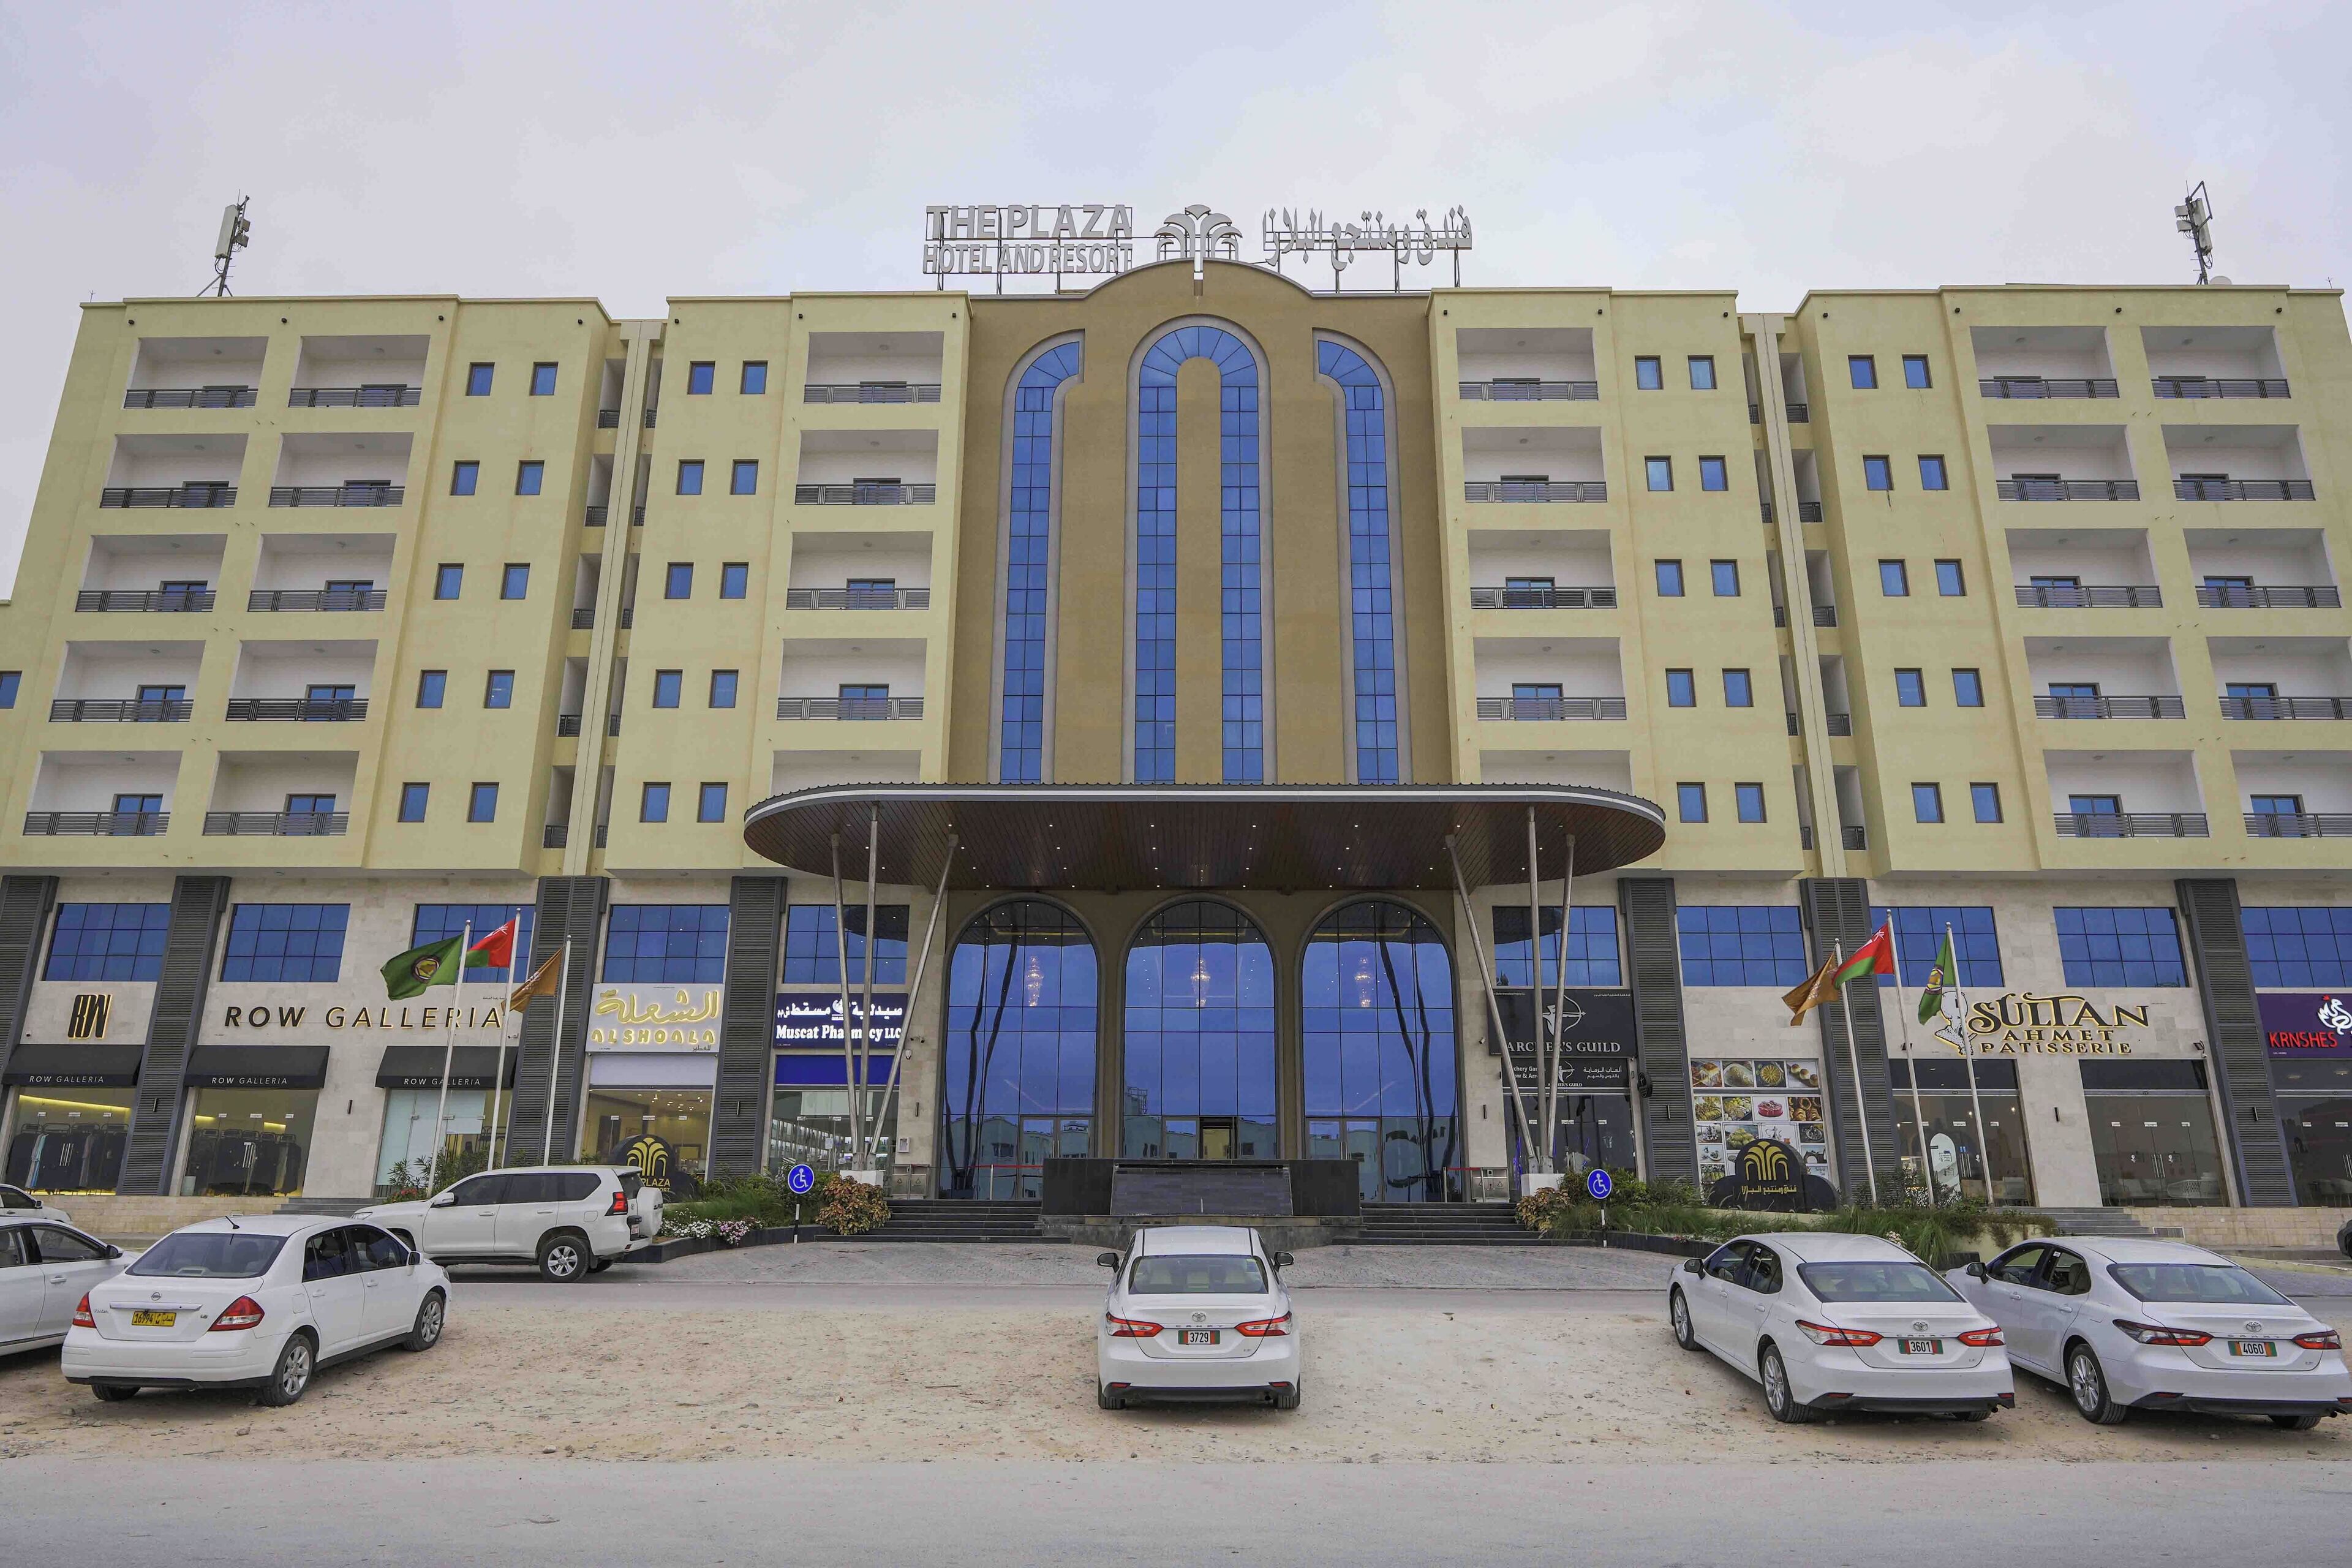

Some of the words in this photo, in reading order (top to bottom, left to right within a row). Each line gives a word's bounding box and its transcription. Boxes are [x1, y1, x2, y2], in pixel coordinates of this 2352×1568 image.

[926, 205, 997, 239] THE
[1007, 204, 1133, 239] PLAZA
[1416, 205, 1472, 266] فندق
[922, 244, 992, 274] HOTEL
[997, 244, 1045, 273] AND
[1049, 243, 1133, 273] RESORT
[595, 989, 718, 1023] الشعلة
[1967, 992, 2150, 1034] SULTAN
[224, 1006, 306, 1028] ROW
[325, 1006, 502, 1029] GALLERIA
[776, 1025, 820, 1039] Muscat
[821, 1025, 883, 1042] Phamcy
[884, 1028, 901, 1039] LLC
[2003, 1030, 2114, 1041] AHMET
[2269, 1031, 2339, 1049] KRNSHES
[1507, 1041, 1572, 1052] ARCE'S
[1576, 1042, 1621, 1052] GUILD
[134, 1313, 153, 1324] 16994
[1189, 1332, 1209, 1343] 3729
[1910, 1341, 1931, 1352] 3601
[2243, 1343, 2264, 1354] 4060
